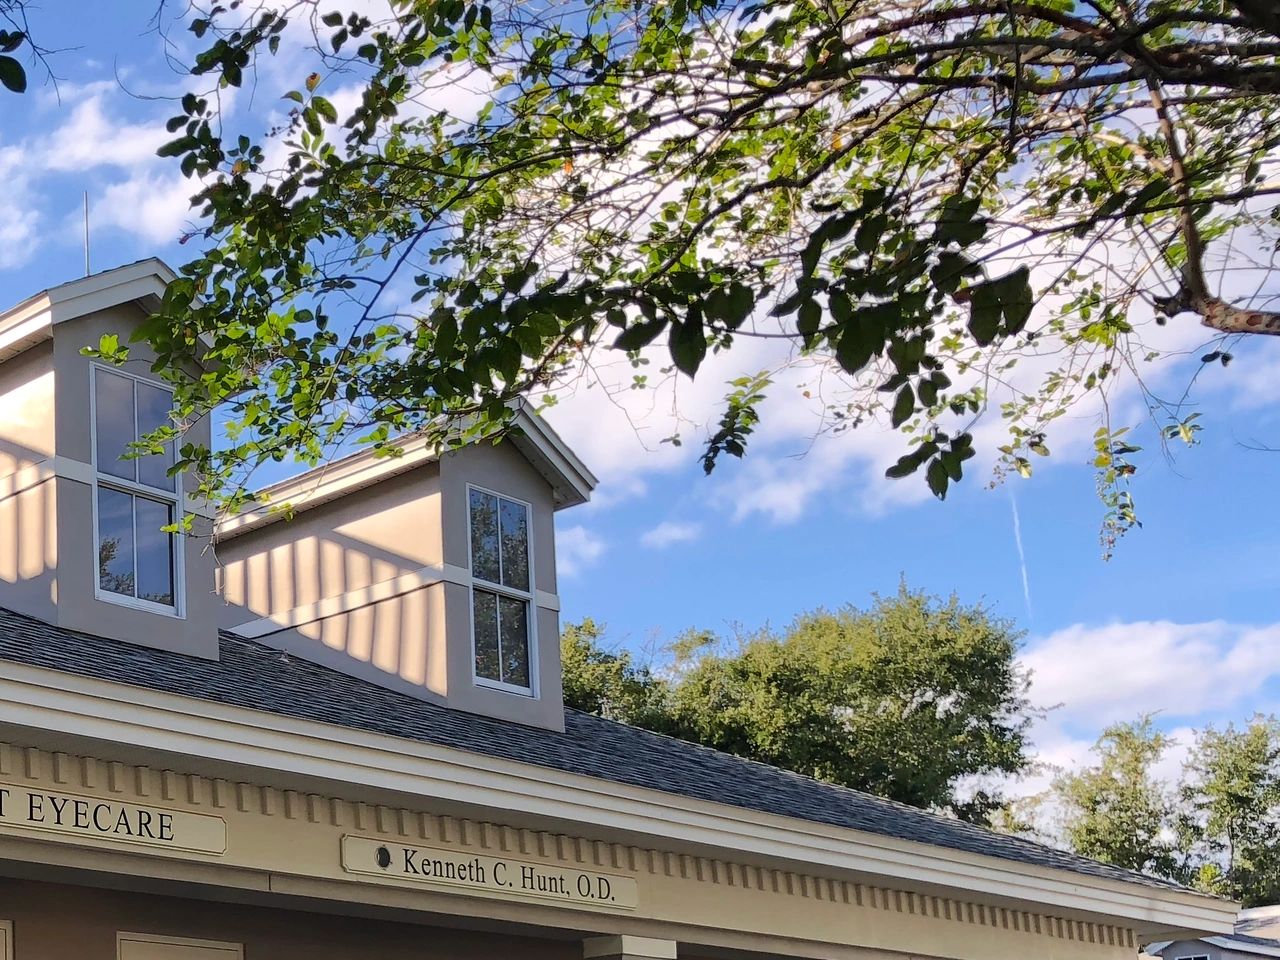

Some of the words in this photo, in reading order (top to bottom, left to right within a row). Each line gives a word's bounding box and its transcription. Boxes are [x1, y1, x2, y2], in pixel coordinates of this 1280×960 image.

[26, 793, 175, 841] EYECARE
[403, 848, 486, 884] Kenneth
[493, 861, 513, 887] C.
[521, 865, 570, 897] Hunt,
[577, 873, 616, 901] O.D.
